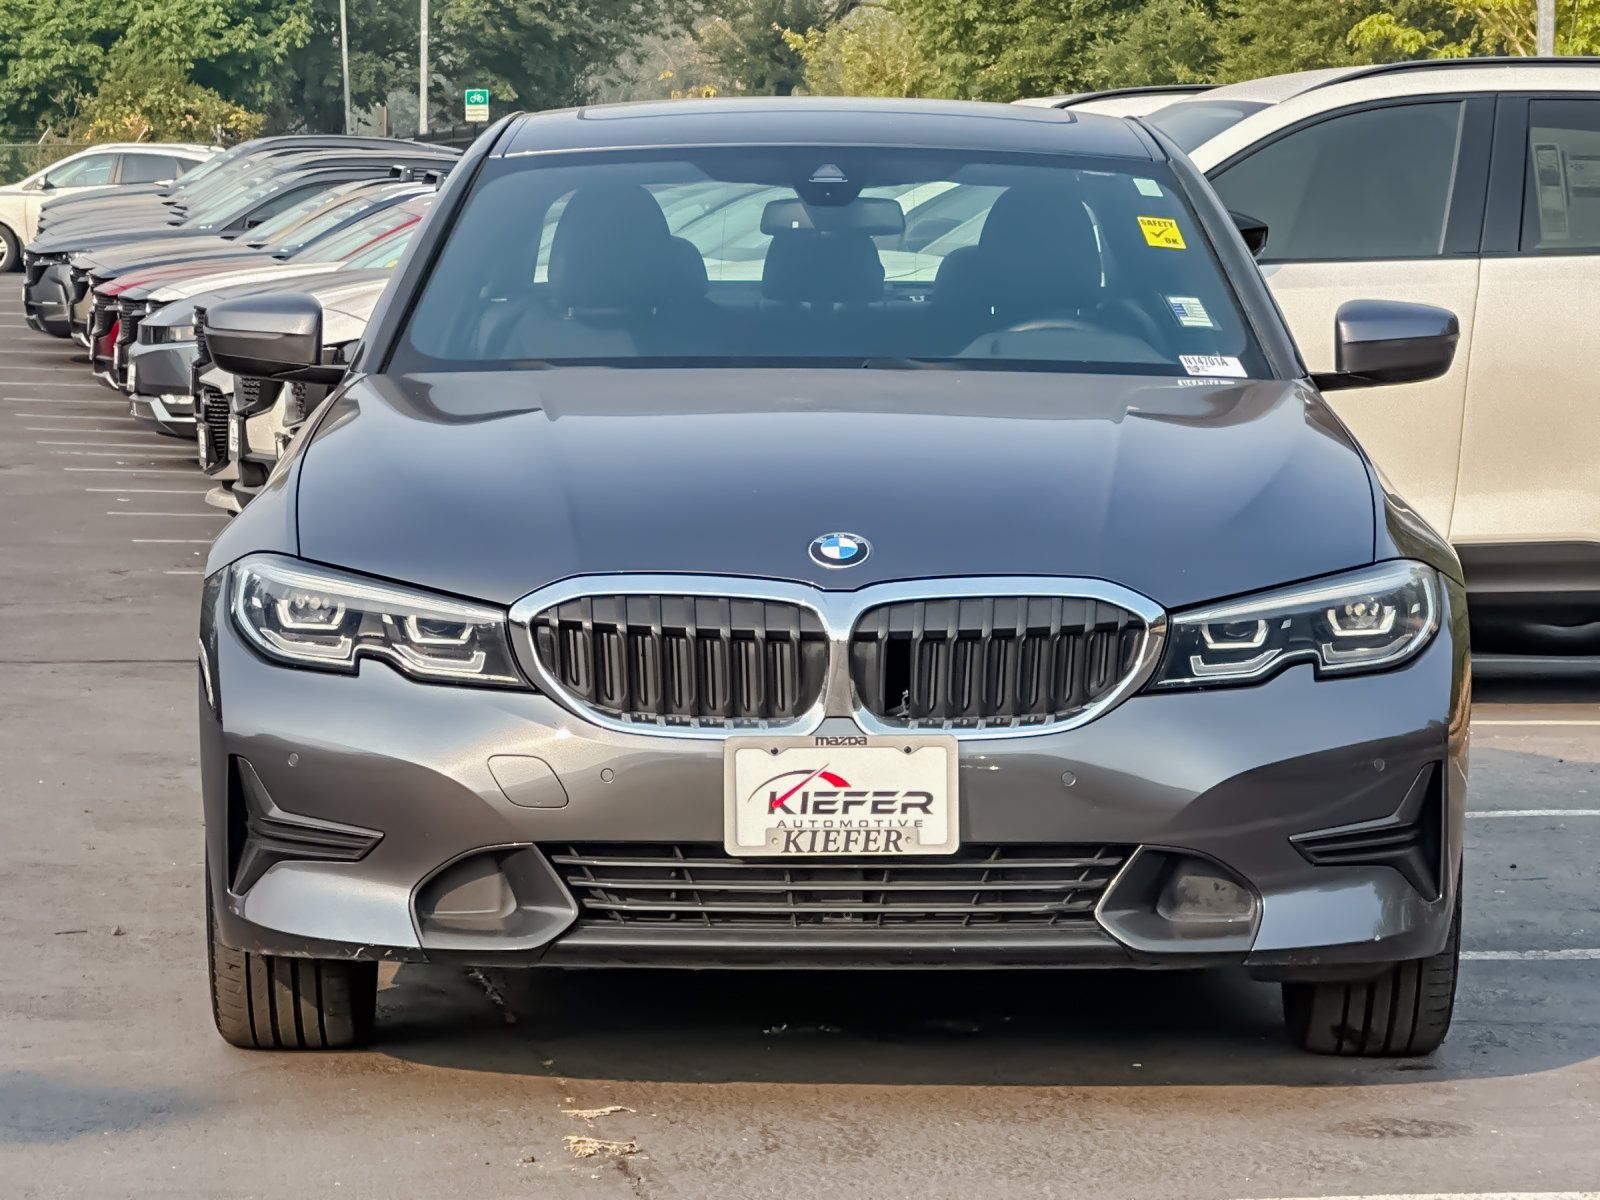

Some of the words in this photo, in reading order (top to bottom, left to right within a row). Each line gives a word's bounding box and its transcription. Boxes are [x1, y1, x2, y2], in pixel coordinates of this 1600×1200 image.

[767, 791, 935, 815] KIEFER
[776, 819, 925, 829] AUTOMOTIVE
[781, 829, 904, 854] KIEFER
